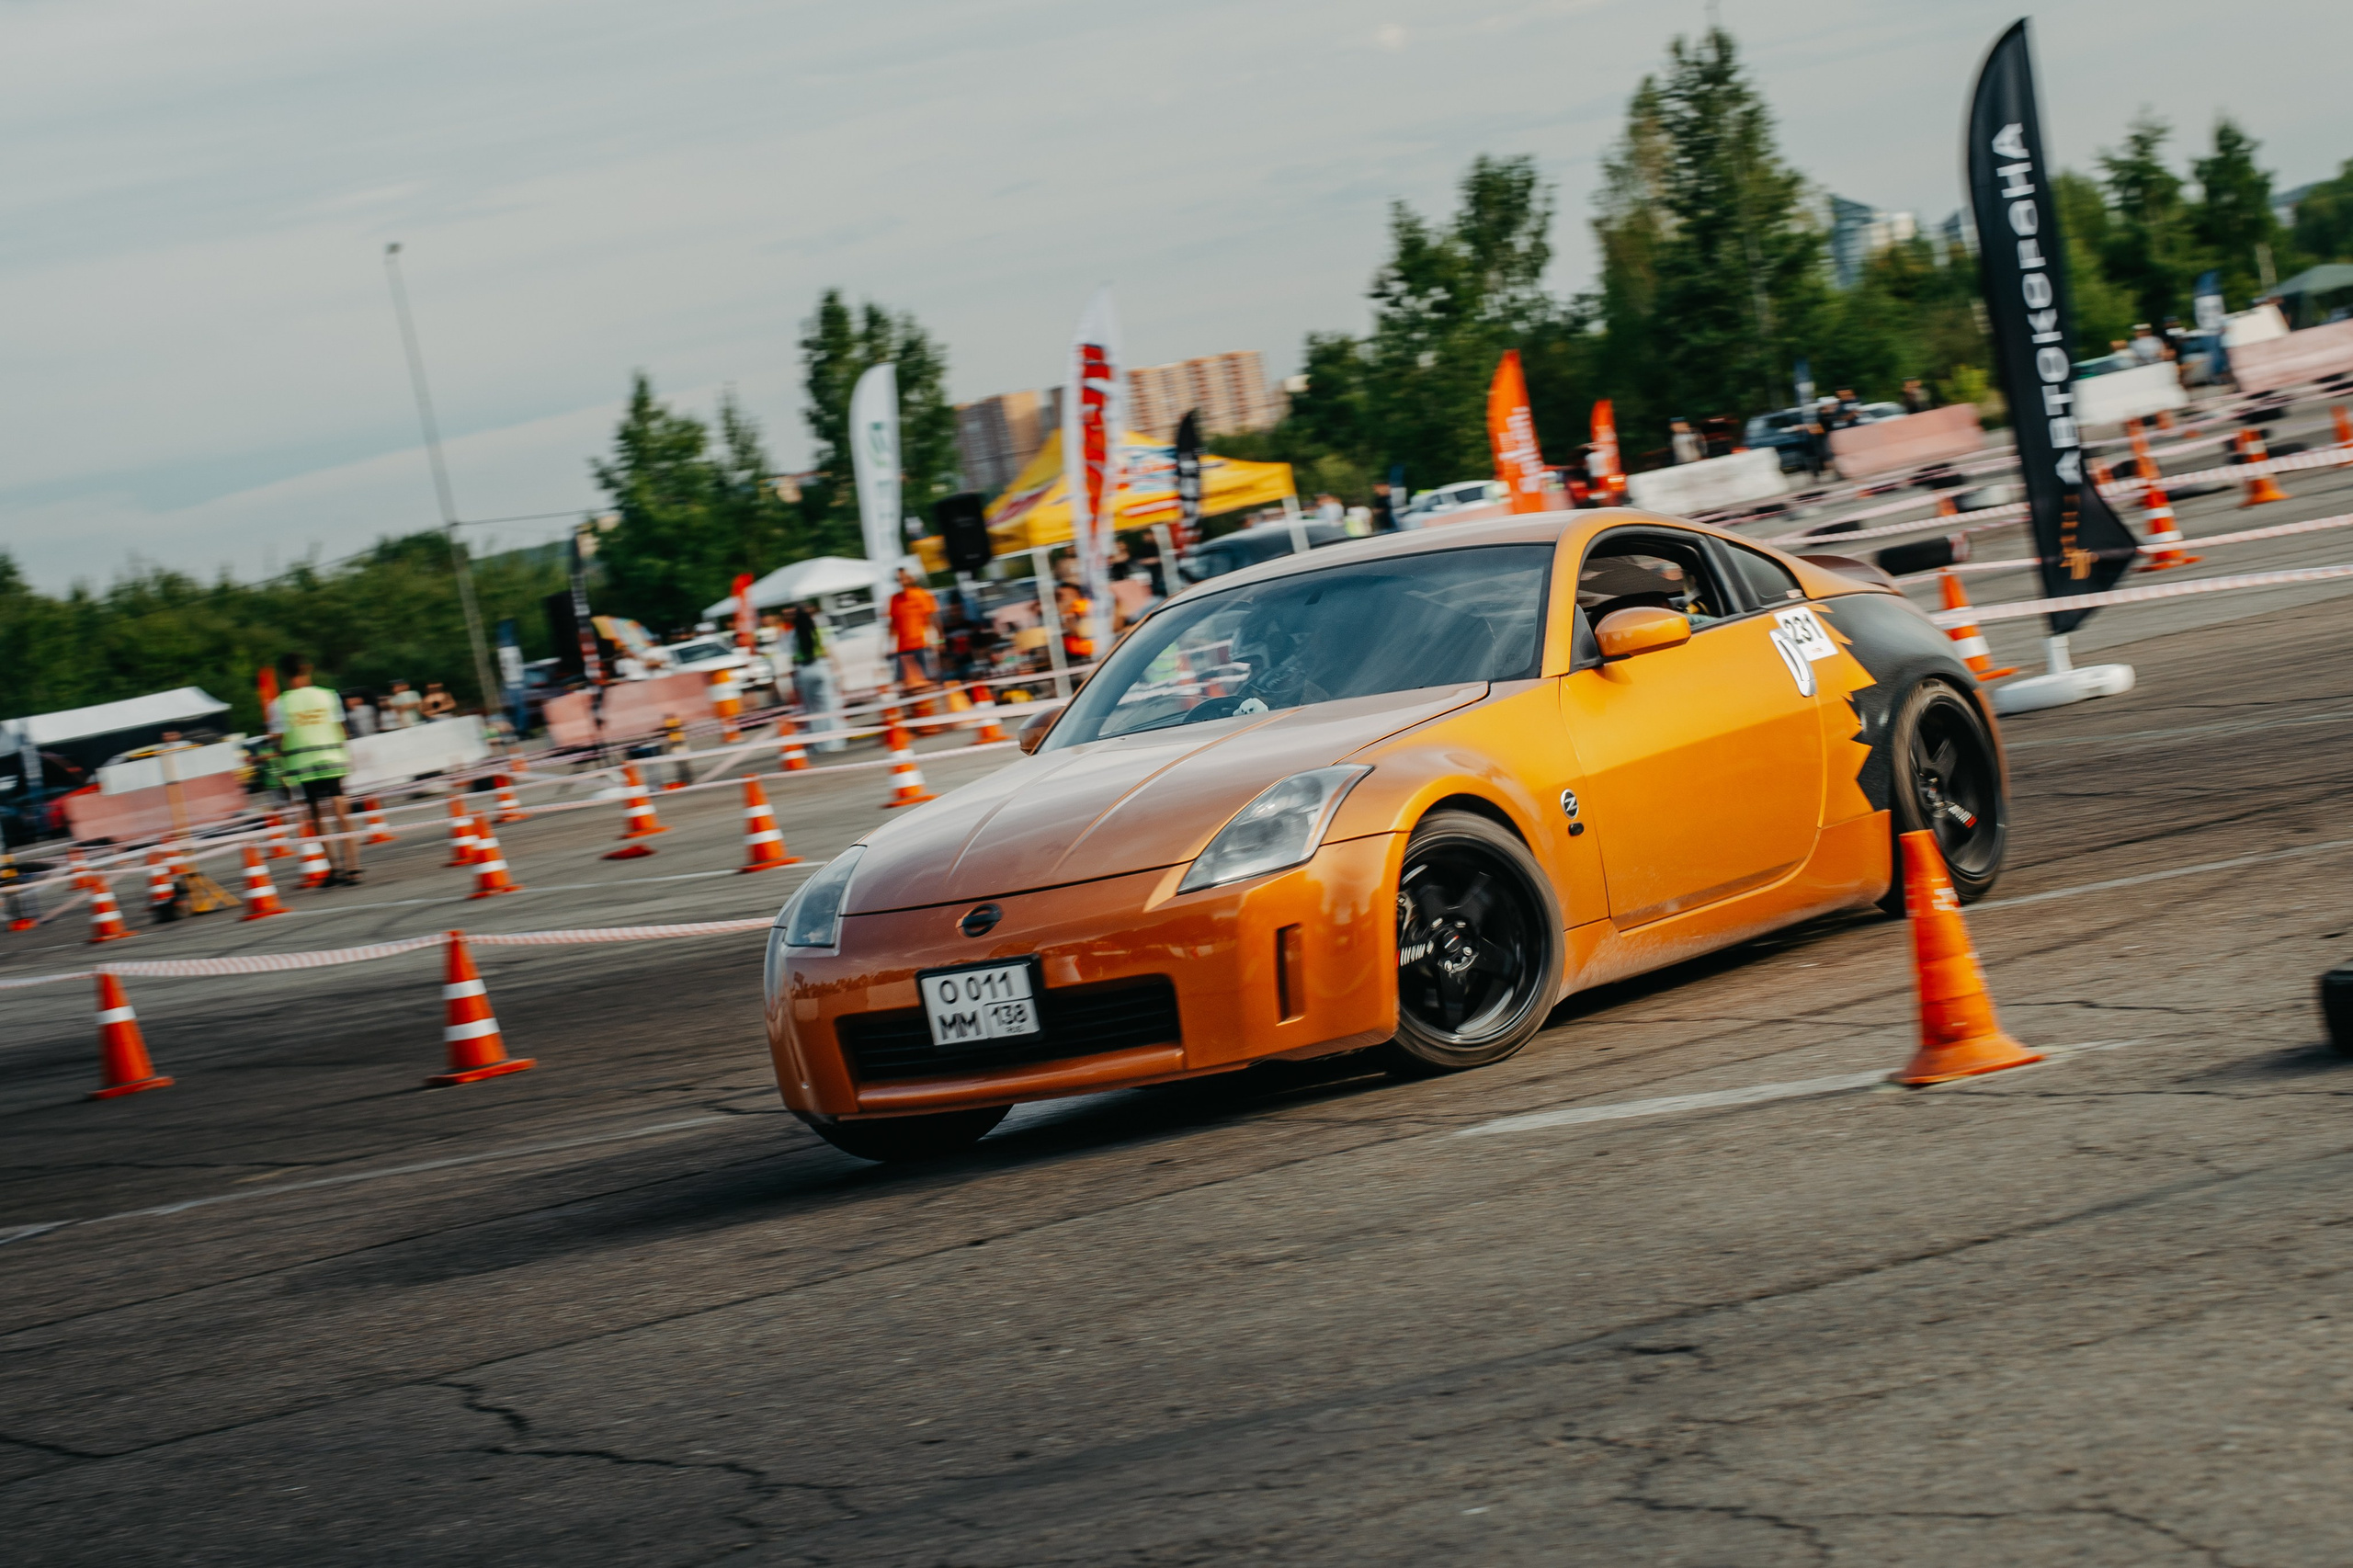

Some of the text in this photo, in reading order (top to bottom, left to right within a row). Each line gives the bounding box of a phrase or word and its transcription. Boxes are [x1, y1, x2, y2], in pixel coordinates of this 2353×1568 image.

[1992, 123, 2083, 484] АВТОКОРОНА
[1783, 613, 1824, 644] 231
[965, 971, 1013, 1002] 011
